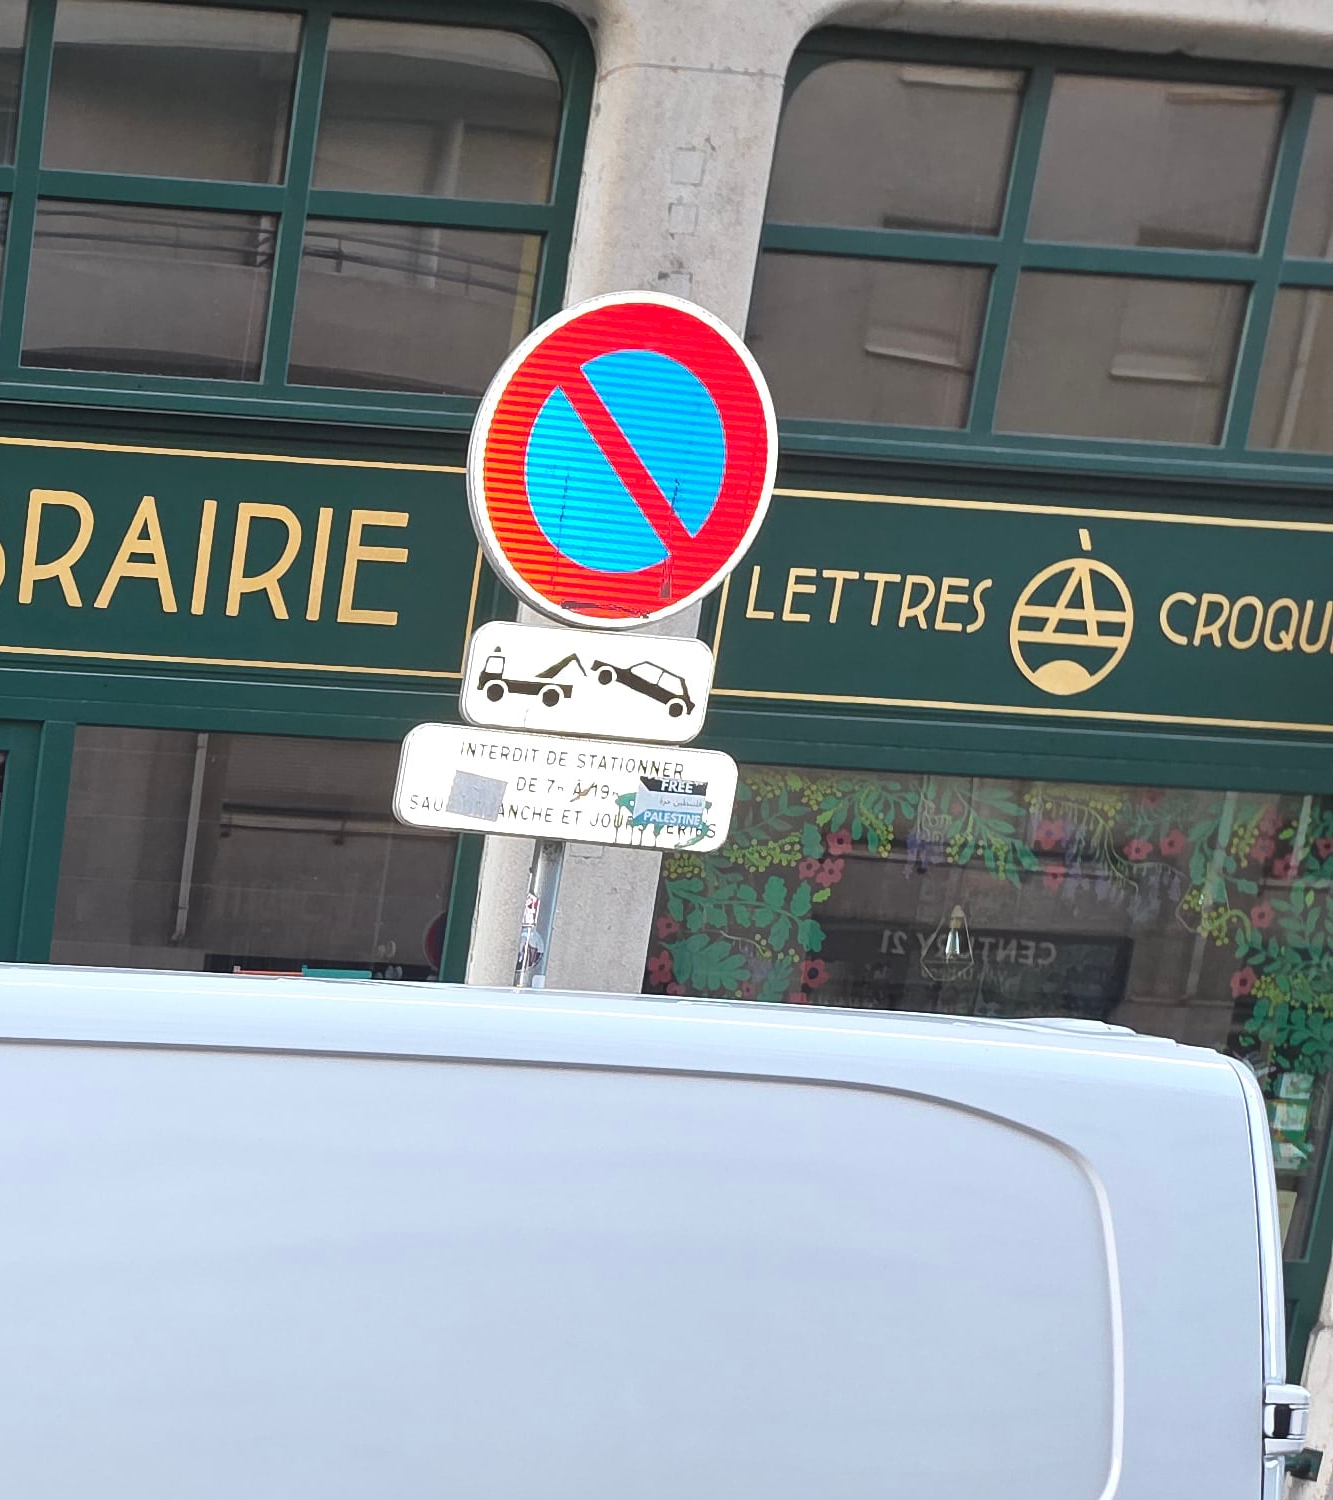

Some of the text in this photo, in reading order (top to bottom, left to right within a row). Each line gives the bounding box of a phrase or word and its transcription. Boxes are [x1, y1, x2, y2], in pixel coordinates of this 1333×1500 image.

[745, 565, 993, 634] LETTRES
[1159, 591, 1333, 655] CROQU
[461, 742, 683, 779] INTERDIT DE STATIONNER
[516, 777, 537, 792] DE
[660, 779, 693, 794] FREE
[410, 795, 444, 812] SAU
[498, 803, 554, 823] ANCHE
[562, 810, 582, 825] ET
[643, 811, 702, 827] PALESTINE
